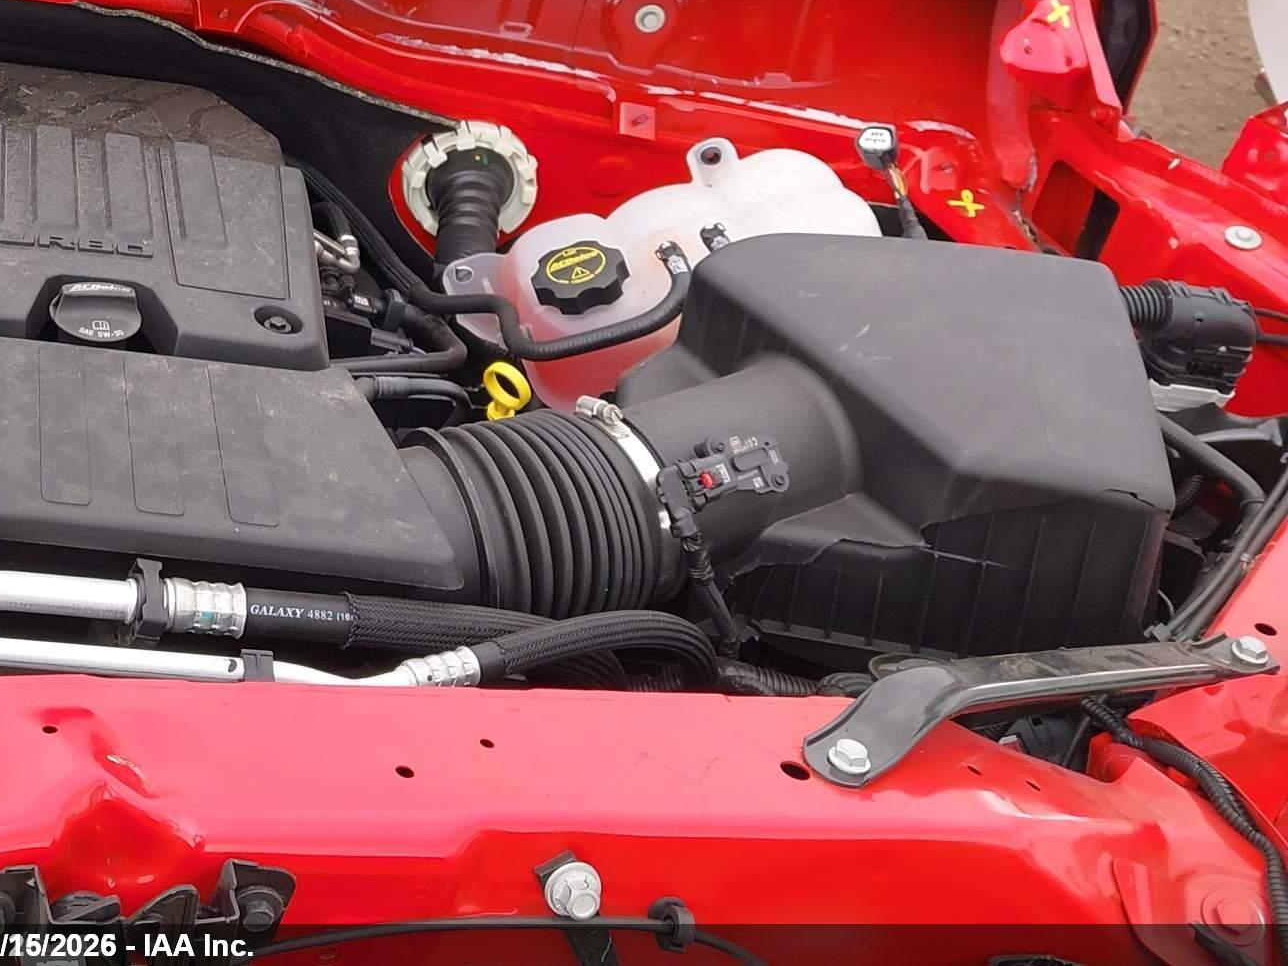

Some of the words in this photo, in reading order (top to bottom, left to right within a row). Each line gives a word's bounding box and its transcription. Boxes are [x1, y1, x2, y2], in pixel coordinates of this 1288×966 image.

[69, 283, 130, 293] ACDelco
[250, 604, 305, 619] GALAXY
[307, 609, 333, 621] 4882
